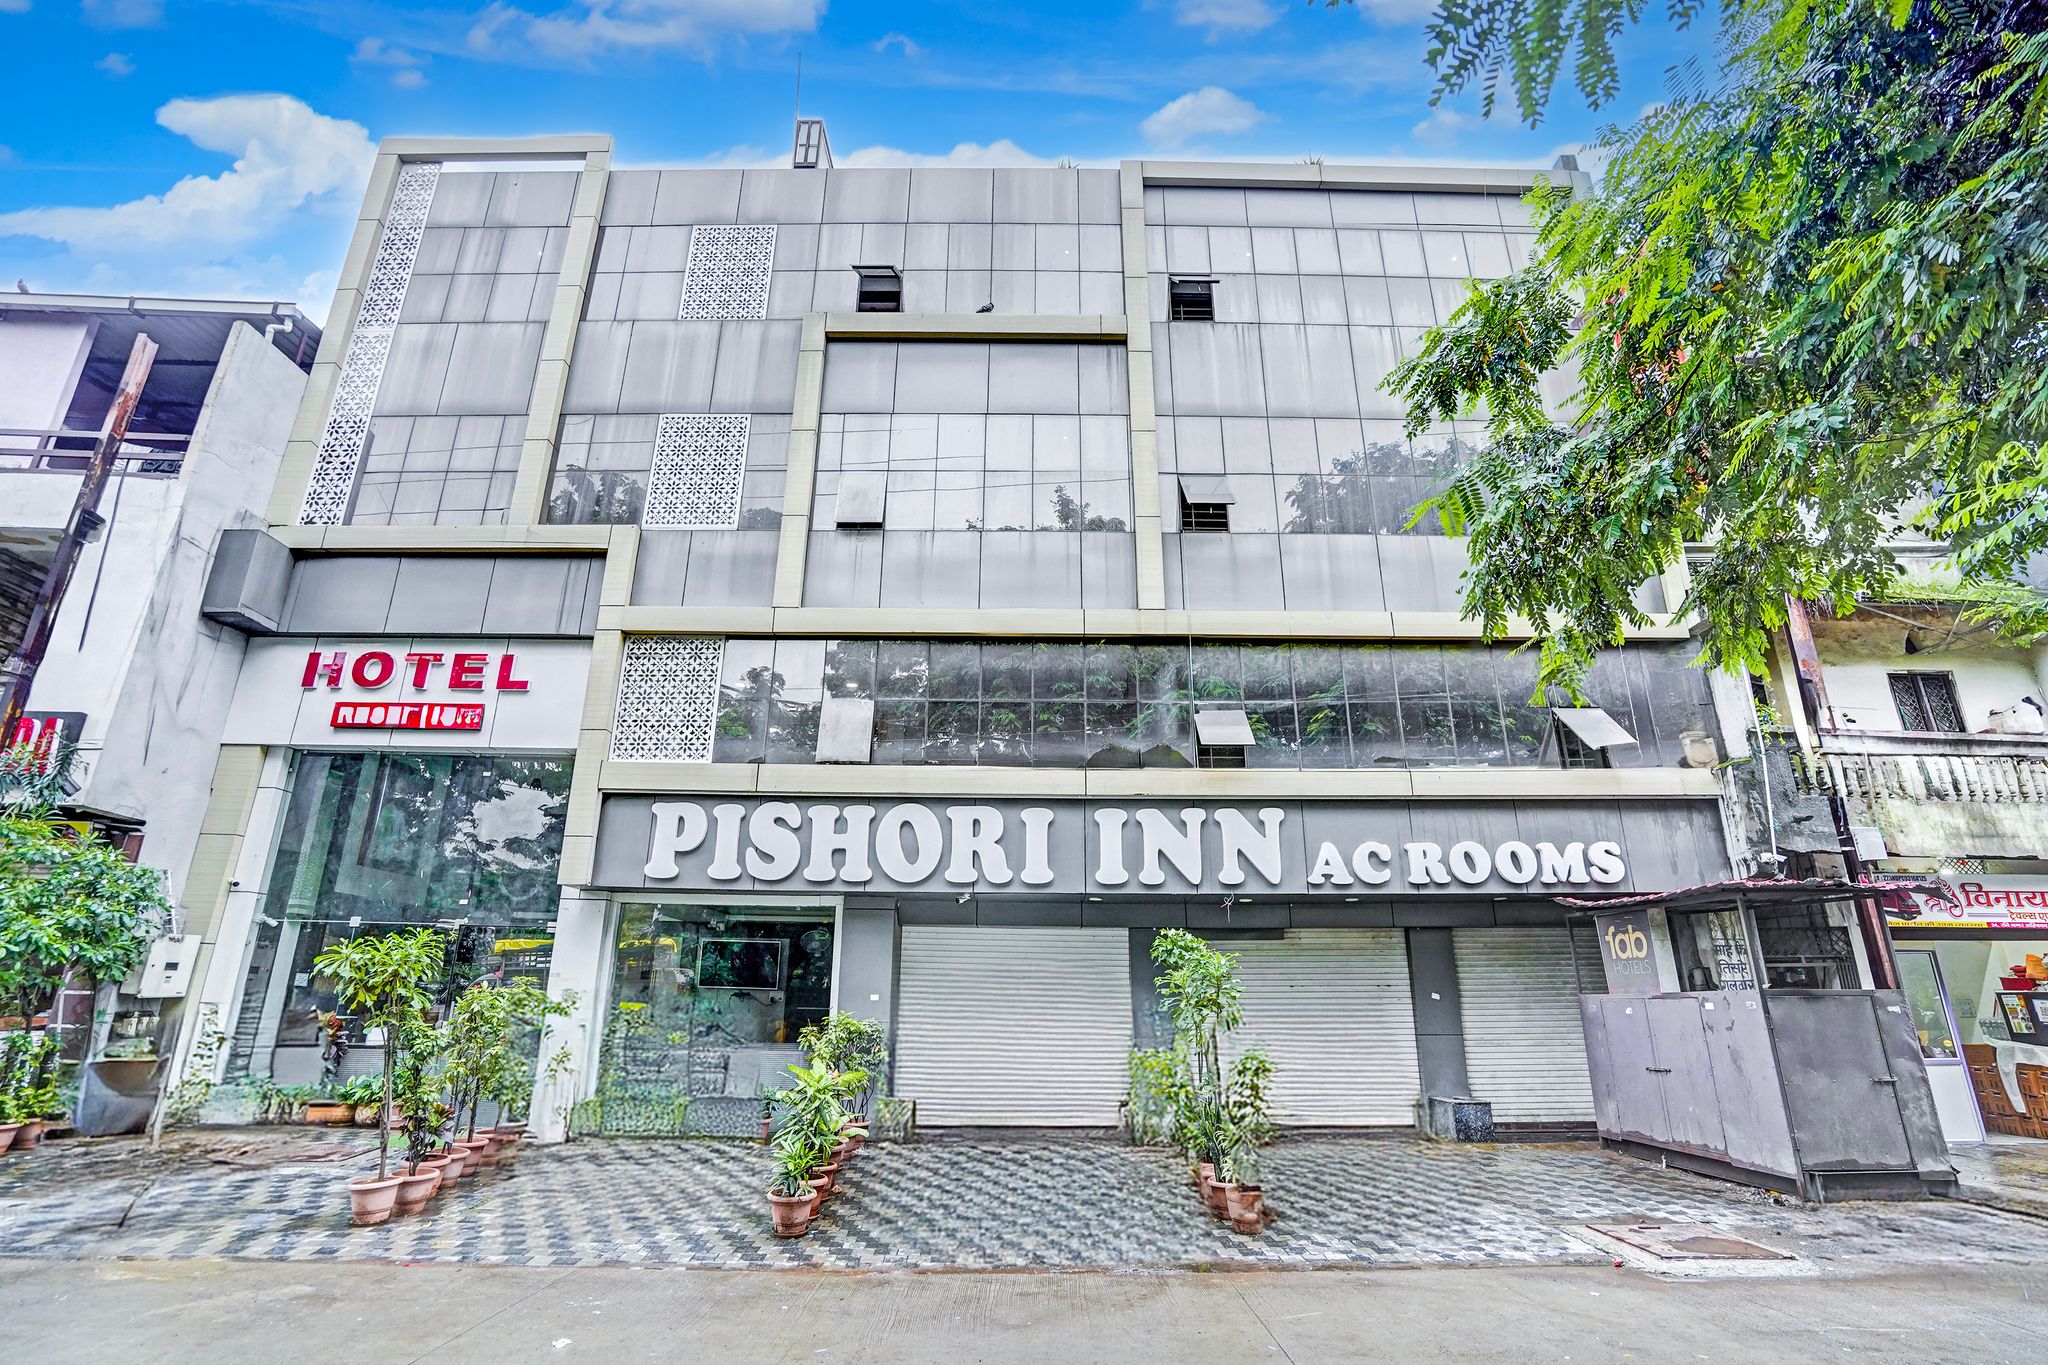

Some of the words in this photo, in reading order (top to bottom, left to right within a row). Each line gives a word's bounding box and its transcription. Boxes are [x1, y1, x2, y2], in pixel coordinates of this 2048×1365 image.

[300, 651, 530, 693] HOTEL
[644, 801, 1055, 885] PISHORI
[1094, 807, 1286, 886] INN
[1307, 841, 1393, 885] AC
[1403, 841, 1627, 885] ROOMS
[1605, 924, 1648, 960] fab
[1613, 960, 1652, 975] HOTELS
